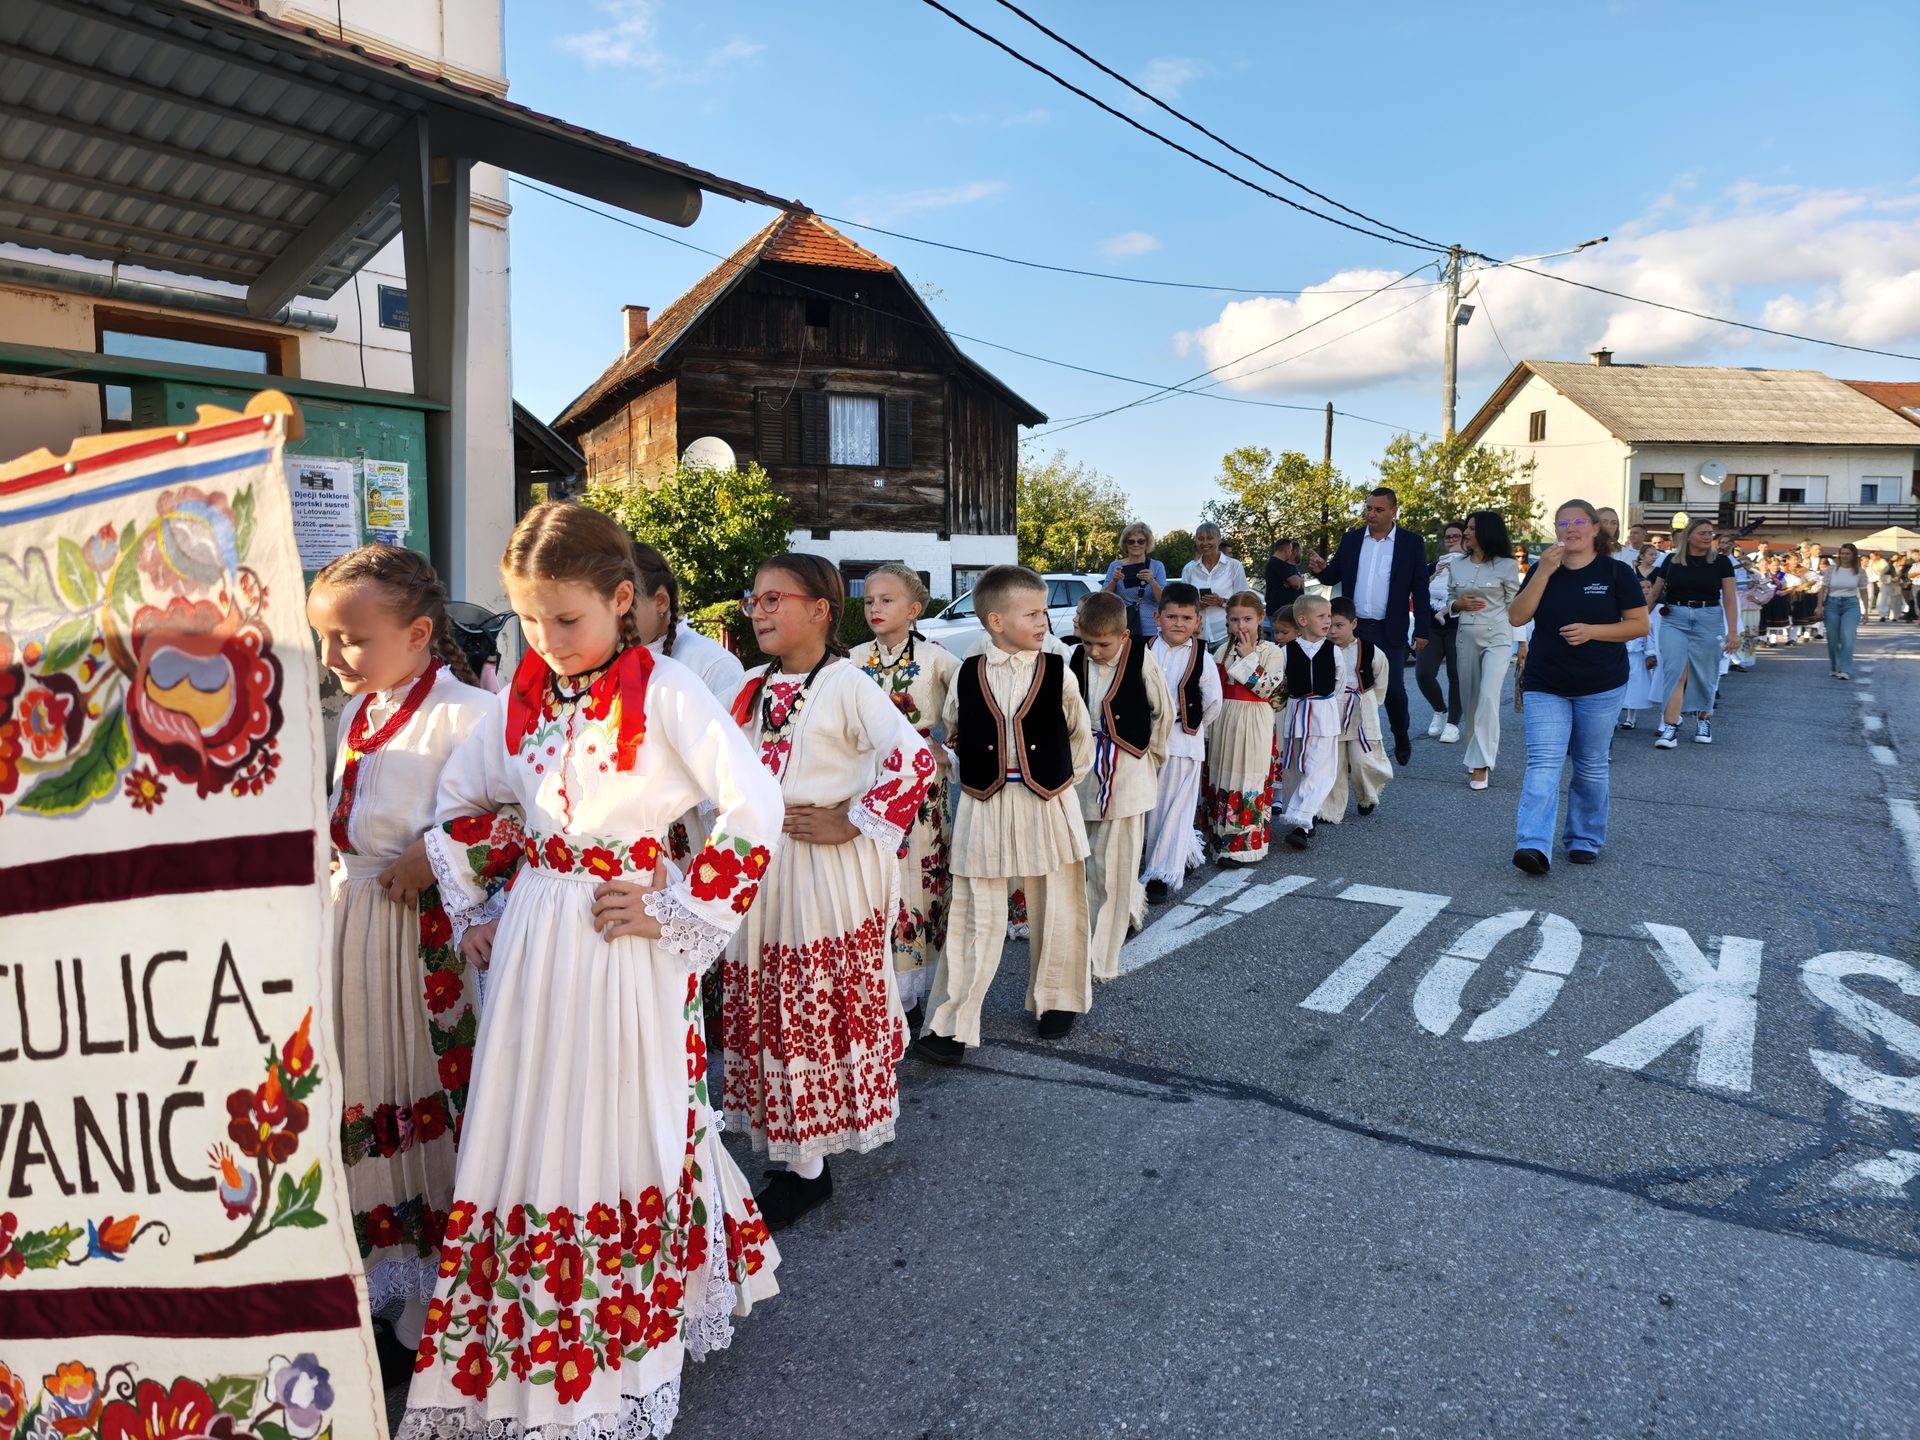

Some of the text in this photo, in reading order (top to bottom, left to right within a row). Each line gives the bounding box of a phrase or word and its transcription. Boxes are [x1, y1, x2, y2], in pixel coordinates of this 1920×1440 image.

[294, 491, 350, 500] Dječji folklorni
[0, 941, 293, 1062] ULICA-
